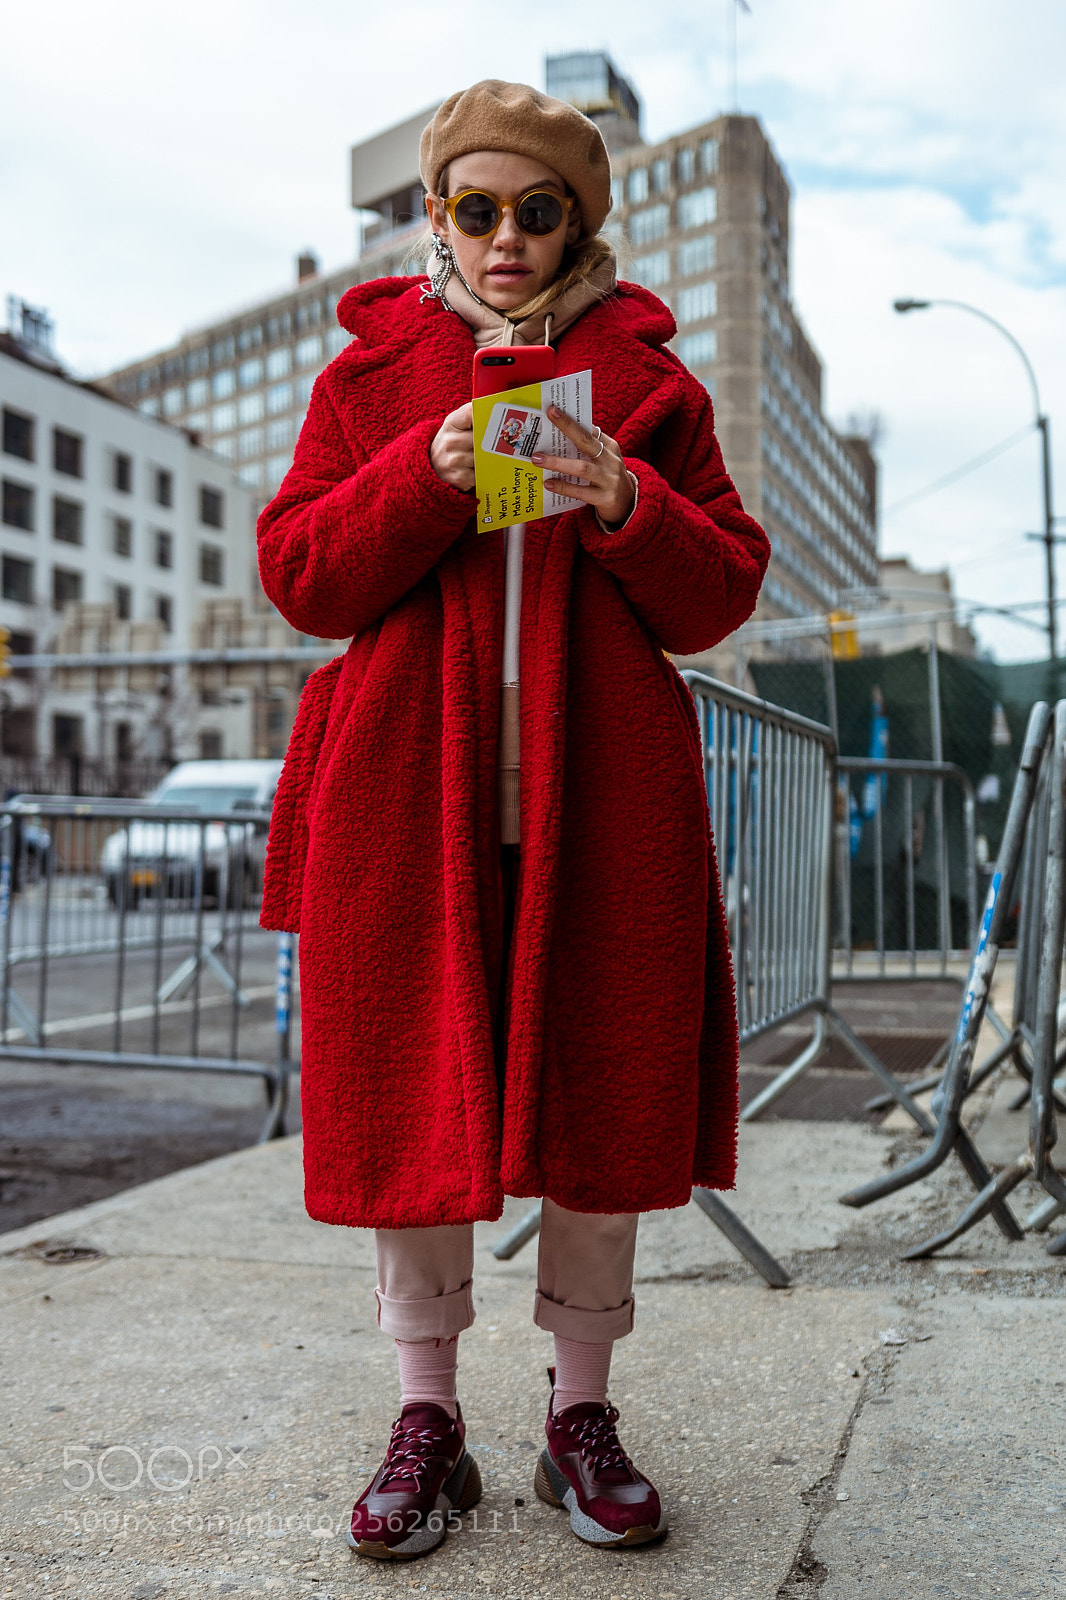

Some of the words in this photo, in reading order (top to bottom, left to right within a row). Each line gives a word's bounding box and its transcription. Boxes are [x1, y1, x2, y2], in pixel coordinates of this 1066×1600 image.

[512, 467, 523, 494] Money
[498, 487, 507, 497] To
[525, 472, 537, 513] Shopping?
[499, 499, 508, 520] Want
[512, 495, 521, 517] Make
